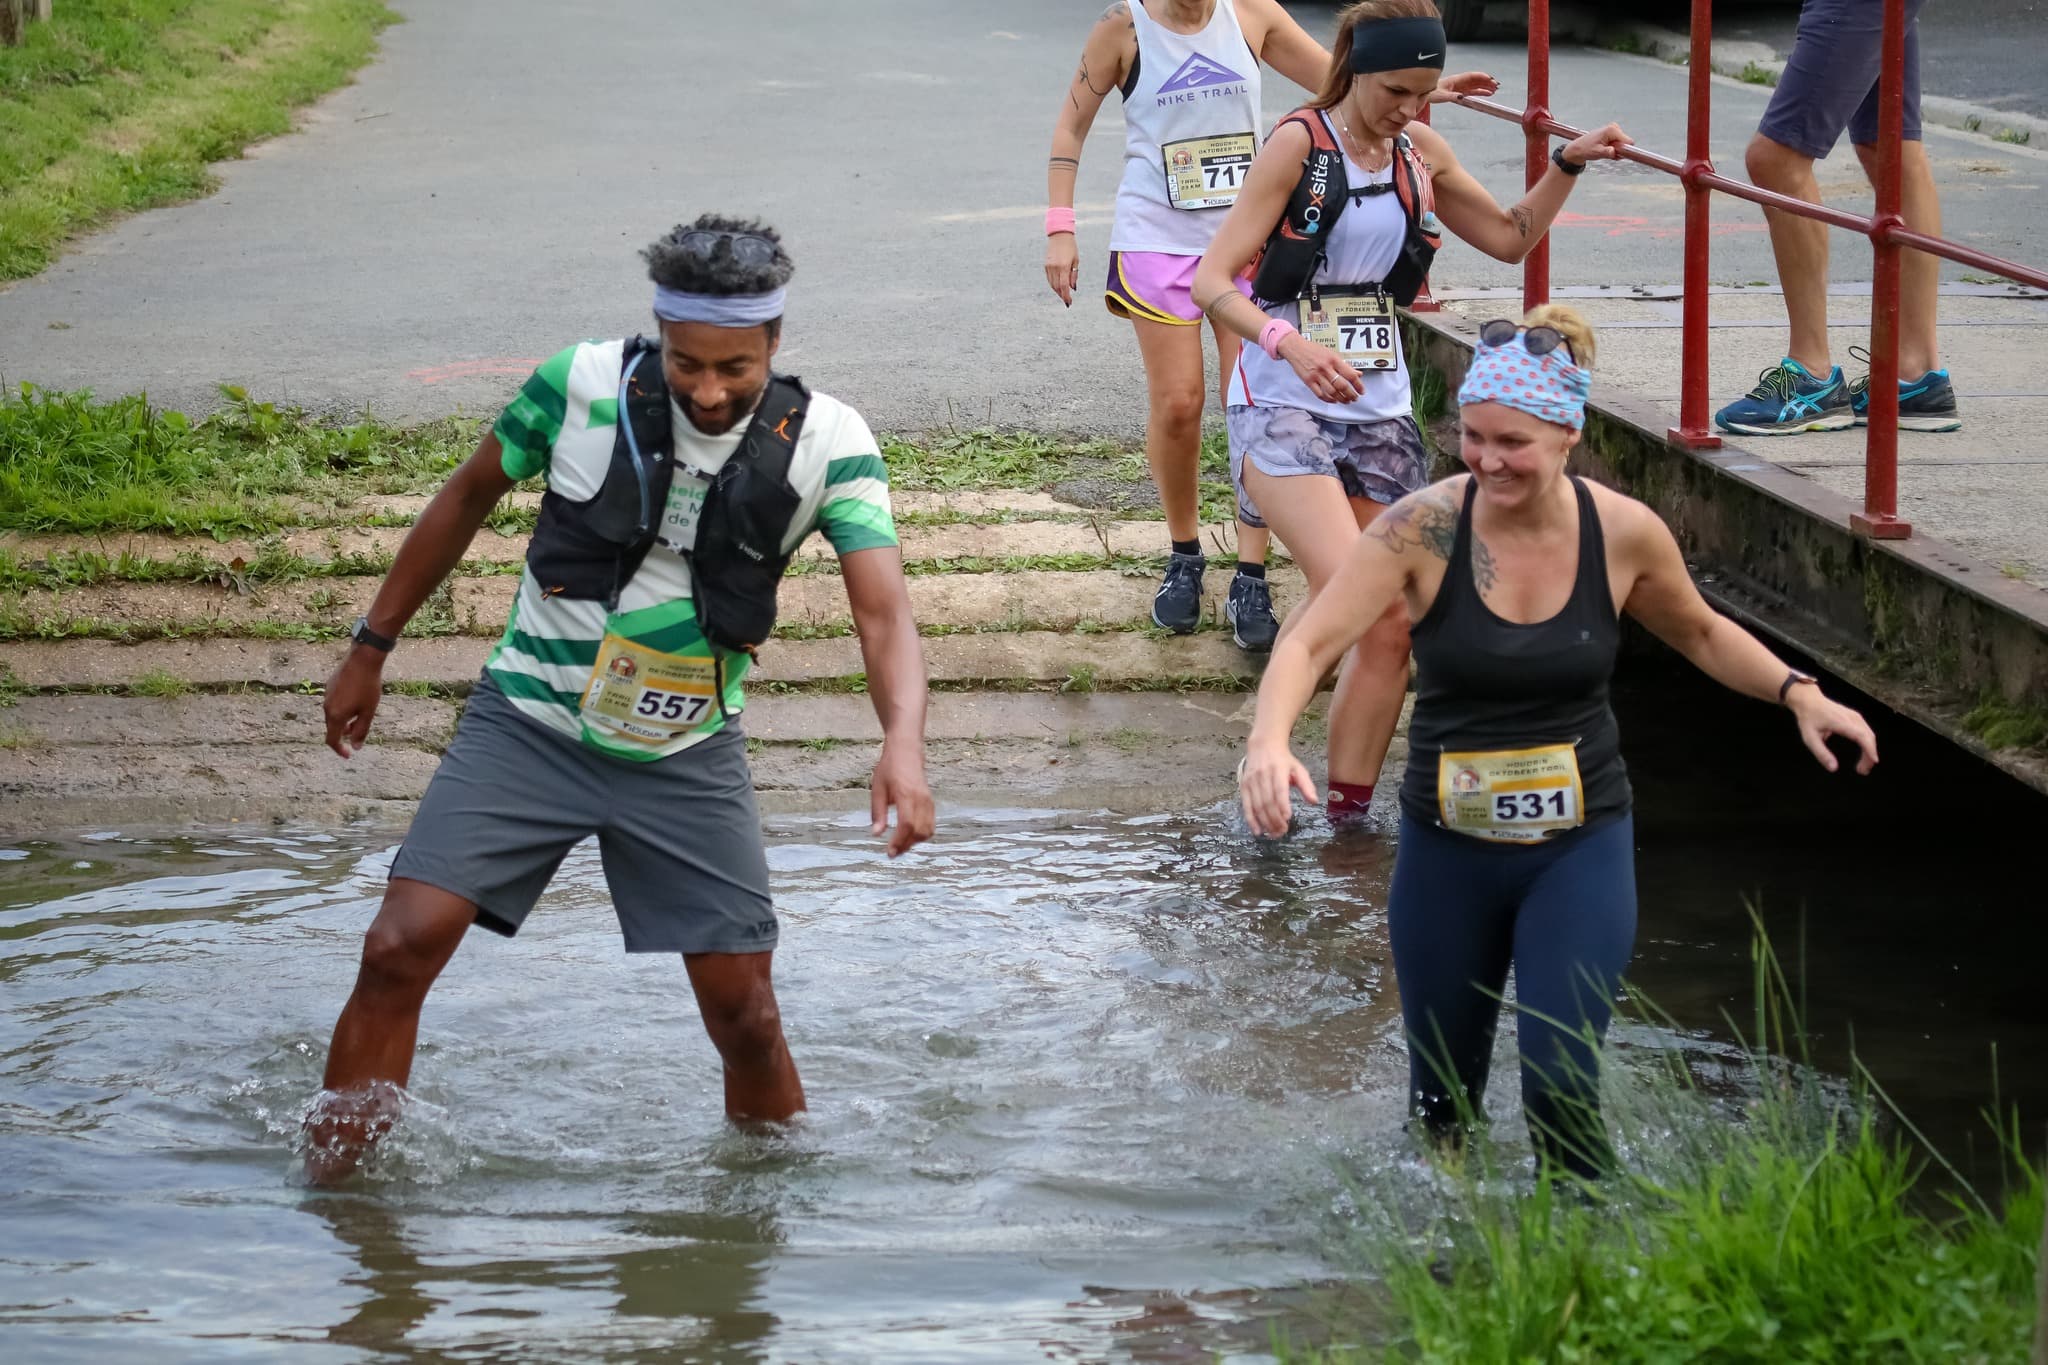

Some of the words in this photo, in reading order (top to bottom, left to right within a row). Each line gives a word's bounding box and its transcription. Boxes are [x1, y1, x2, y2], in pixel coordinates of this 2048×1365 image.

[1157, 93, 1195, 107] NIKE
[1202, 86, 1247, 99] TRAIL
[1204, 165, 1250, 189] 717
[1340, 327, 1390, 349] 718
[637, 690, 710, 721] 557
[1496, 790, 1566, 820] 531
